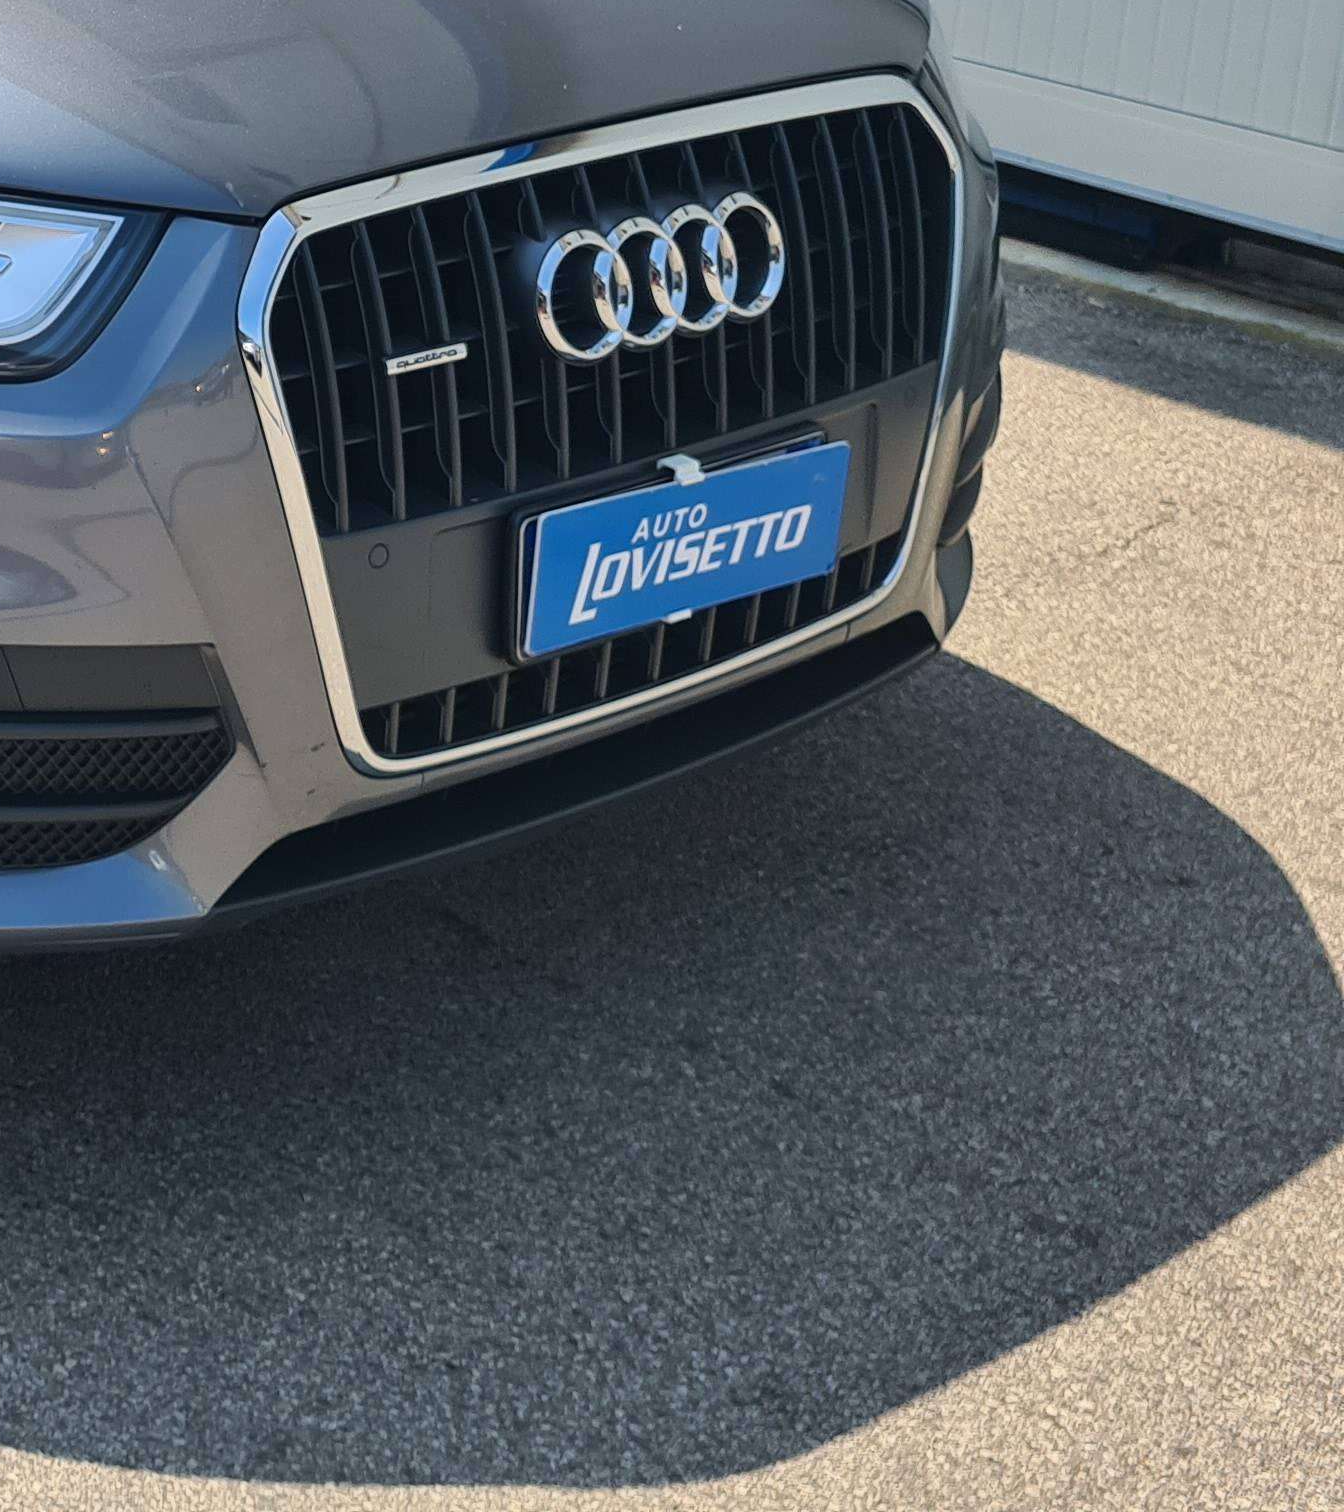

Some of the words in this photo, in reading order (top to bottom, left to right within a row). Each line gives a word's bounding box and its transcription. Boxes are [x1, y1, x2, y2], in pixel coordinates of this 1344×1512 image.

[396, 349, 458, 369] quattro
[630, 503, 708, 544] AUTO
[568, 504, 812, 626] LOVISETTO
